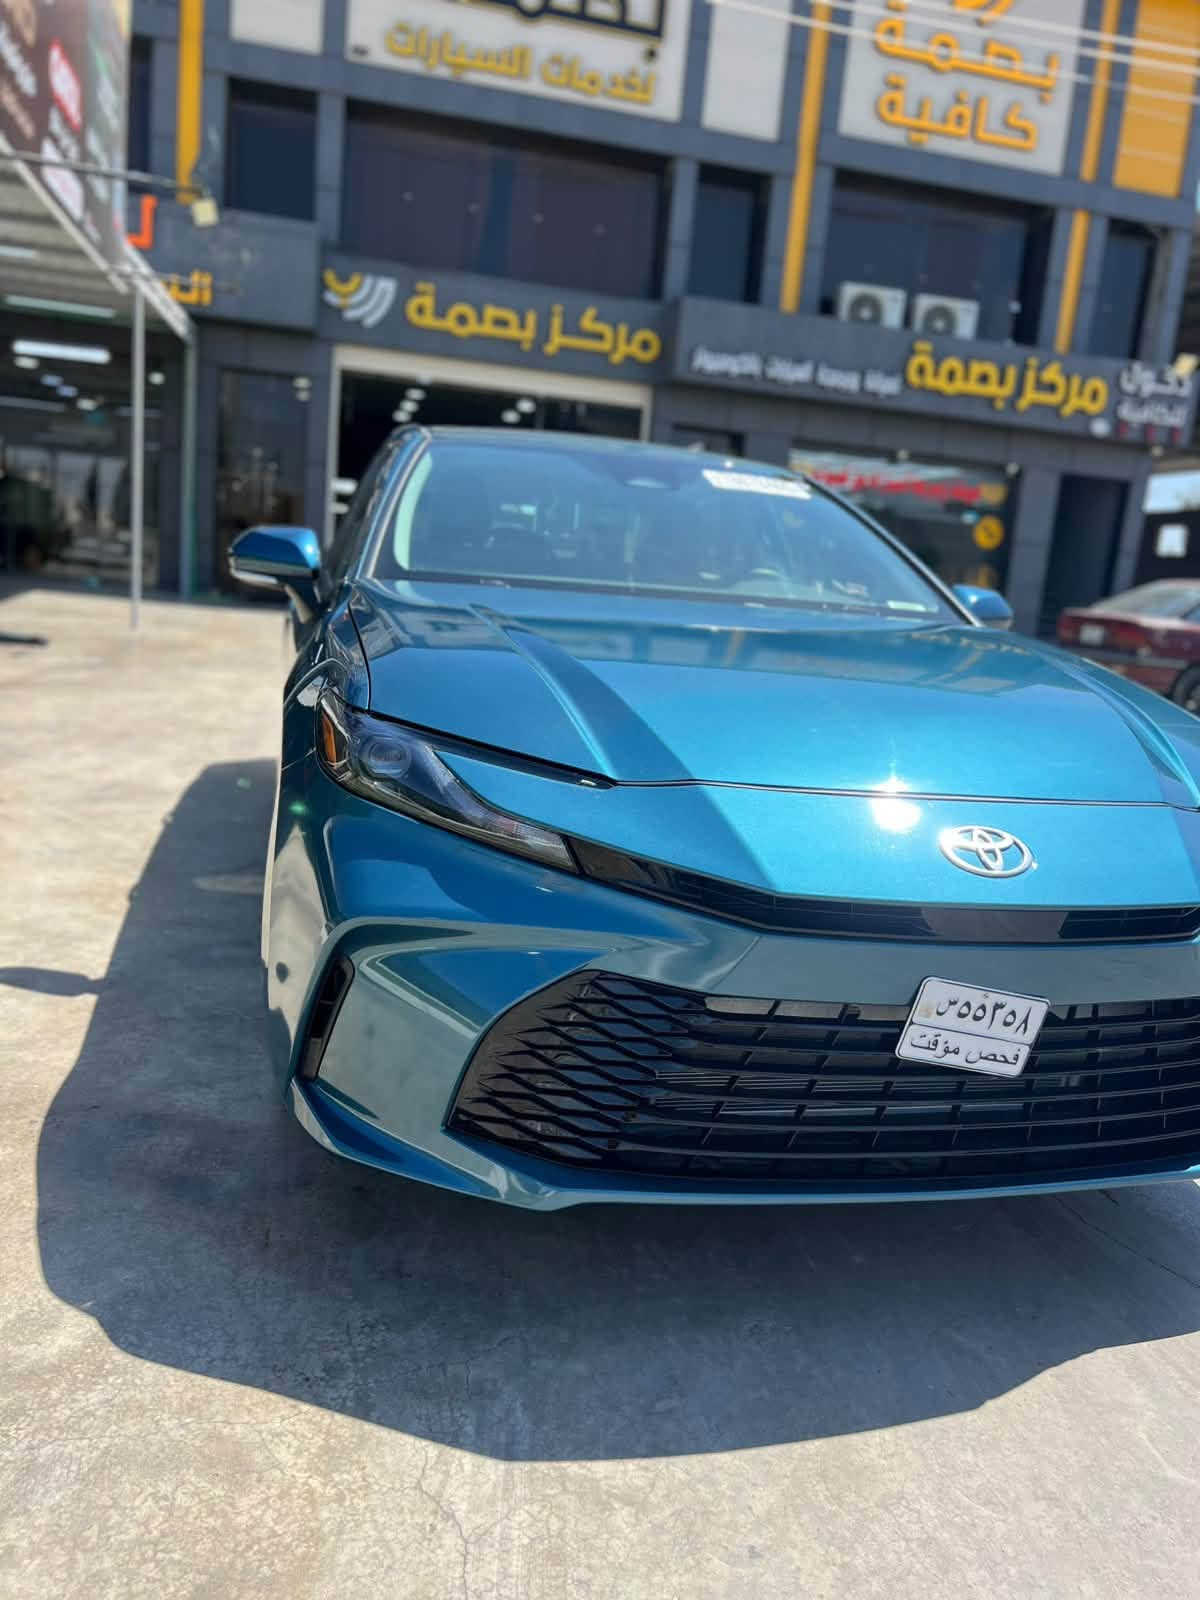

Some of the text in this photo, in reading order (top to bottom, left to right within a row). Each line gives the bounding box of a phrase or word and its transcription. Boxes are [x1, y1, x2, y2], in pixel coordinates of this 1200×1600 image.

[385, 20, 533, 81] السيارات
[540, 54, 656, 104] لخدمات
[876, 72, 1038, 151] كافية
[405, 281, 662, 365] مركز بصمة
[906, 340, 1018, 411] بصمة
[1015, 356, 1109, 418] مركز
[910, 1033, 1021, 1066] فحص مؤقت
